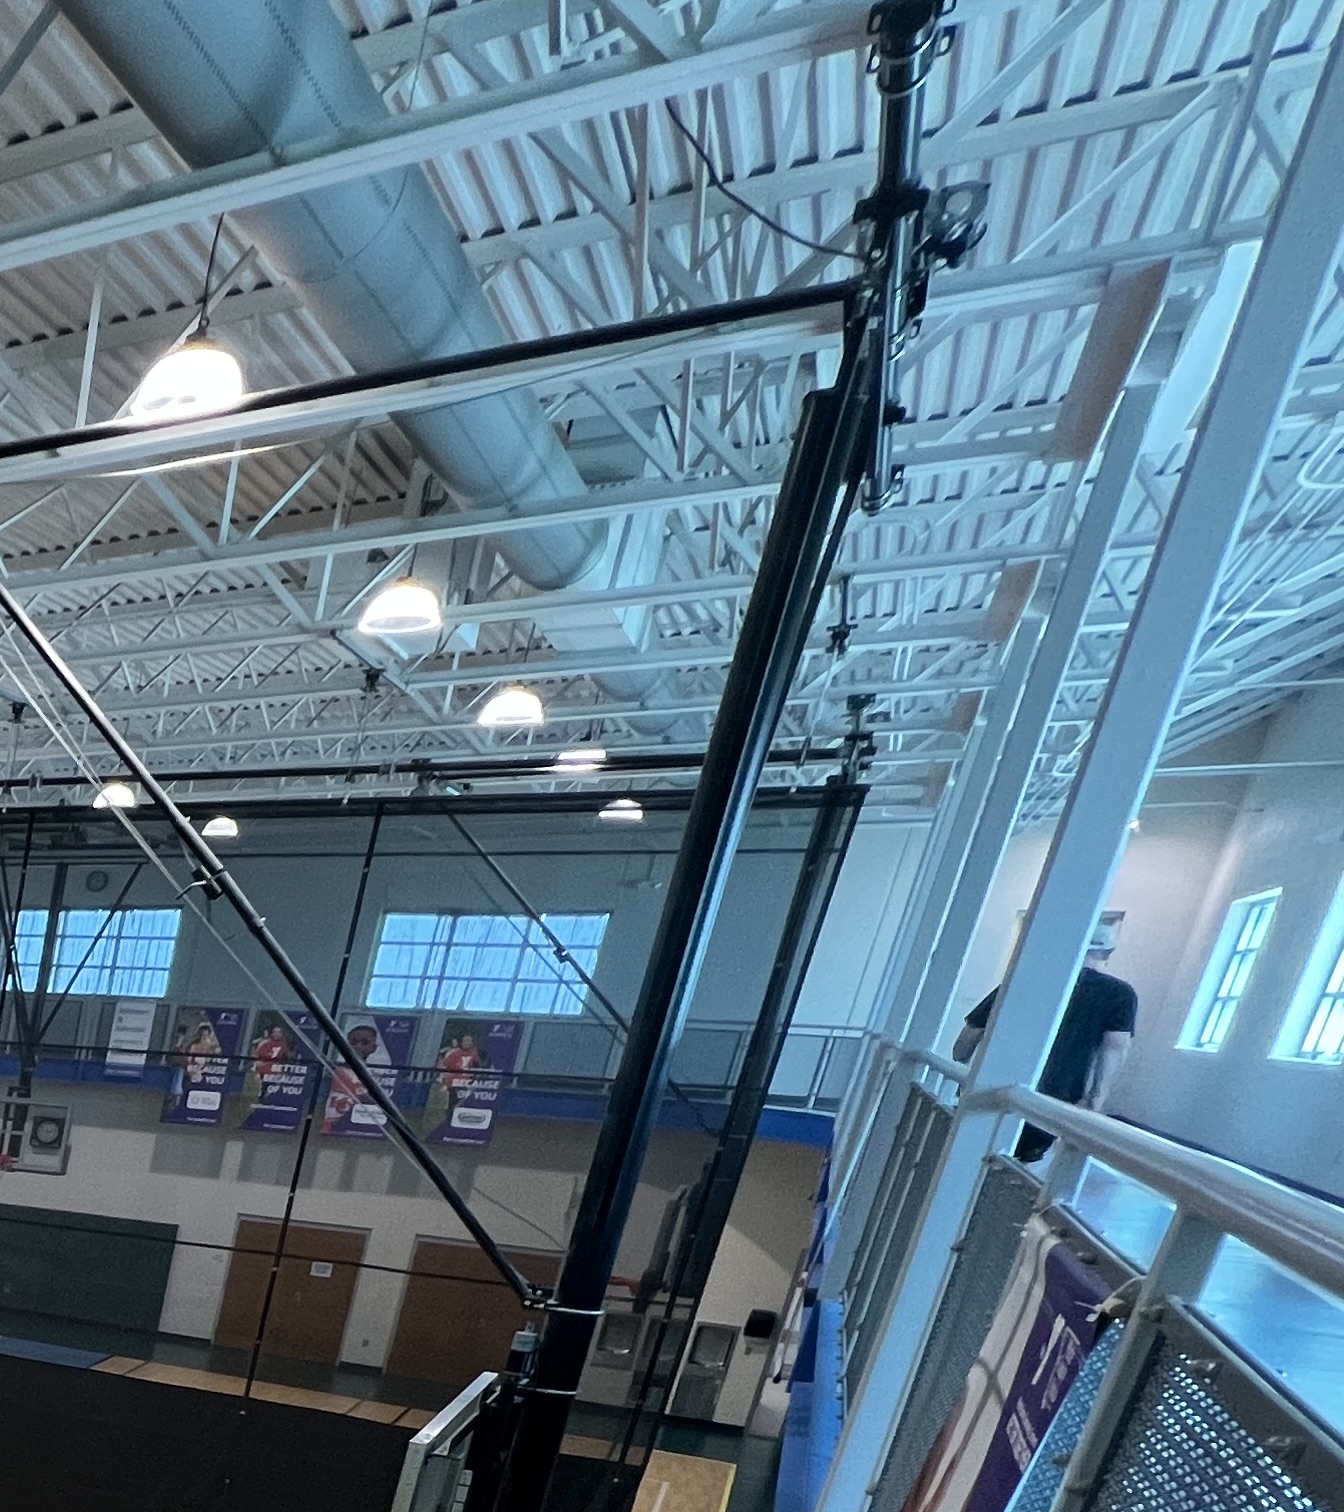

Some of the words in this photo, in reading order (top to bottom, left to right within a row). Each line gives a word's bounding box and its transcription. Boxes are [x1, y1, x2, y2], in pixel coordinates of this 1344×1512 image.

[271, 1064, 308, 1074] BETTER
[205, 1076, 226, 1085] YOU
[263, 1074, 306, 1085] BECAUSE
[452, 1078, 500, 1090] BECAUSE
[267, 1085, 281, 1095] OF
[283, 1085, 303, 1096] YOU
[457, 1090, 472, 1100] OF
[474, 1090, 499, 1102] YOU
